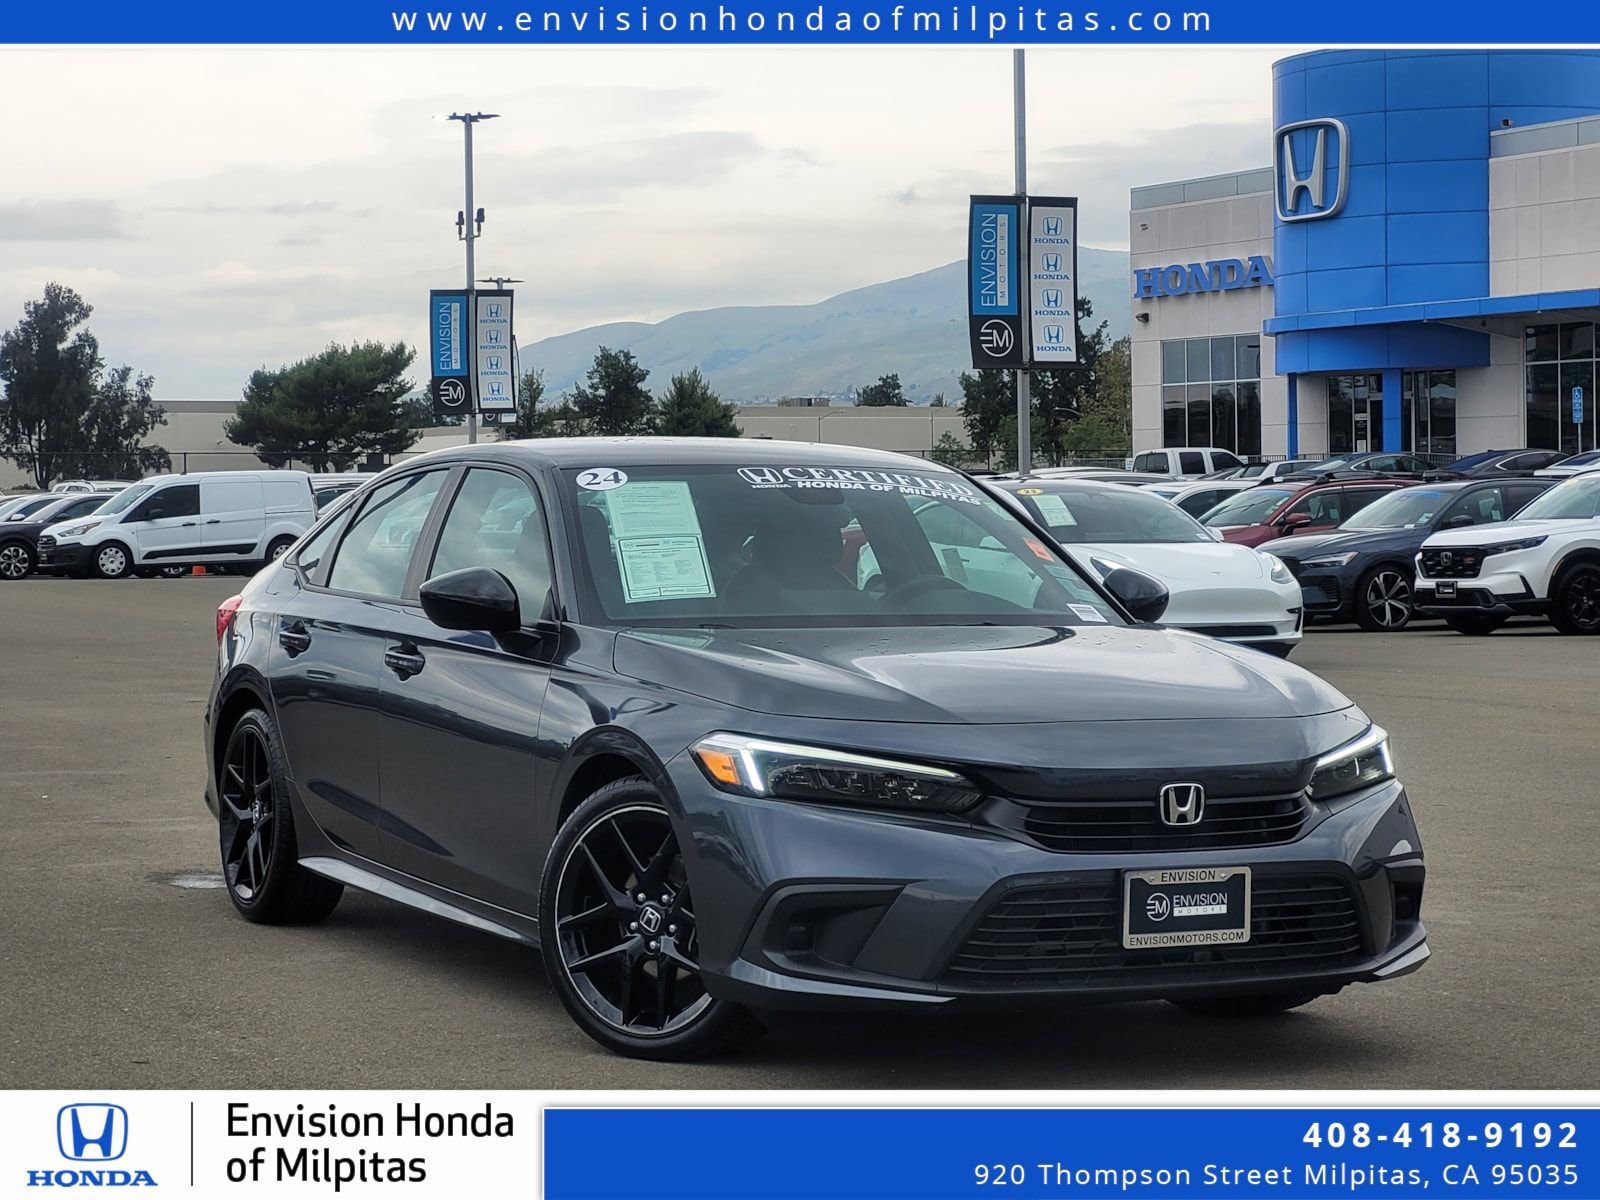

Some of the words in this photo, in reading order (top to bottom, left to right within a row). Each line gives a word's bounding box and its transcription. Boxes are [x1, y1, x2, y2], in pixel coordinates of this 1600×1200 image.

[1034, 237, 1070, 245] HONDA
[981, 213, 997, 307] ENVISION
[1034, 273, 1071, 281] HONDA
[1133, 255, 1274, 299] HONDA
[1034, 309, 1071, 317] HONDA
[439, 302, 451, 370] ENVISION
[1036, 345, 1073, 353] HONDA
[583, 471, 623, 486] 24
[782, 467, 974, 496] CERTIFIED
[797, 481, 866, 490] HONDA
[870, 484, 894, 492] OF
[899, 486, 982, 506] MILPITAS
[1161, 870, 1216, 882] ENVISION
[1173, 892, 1228, 907] ENVISION
[1129, 931, 1245, 946] ENVISIONMOTORS.COM
